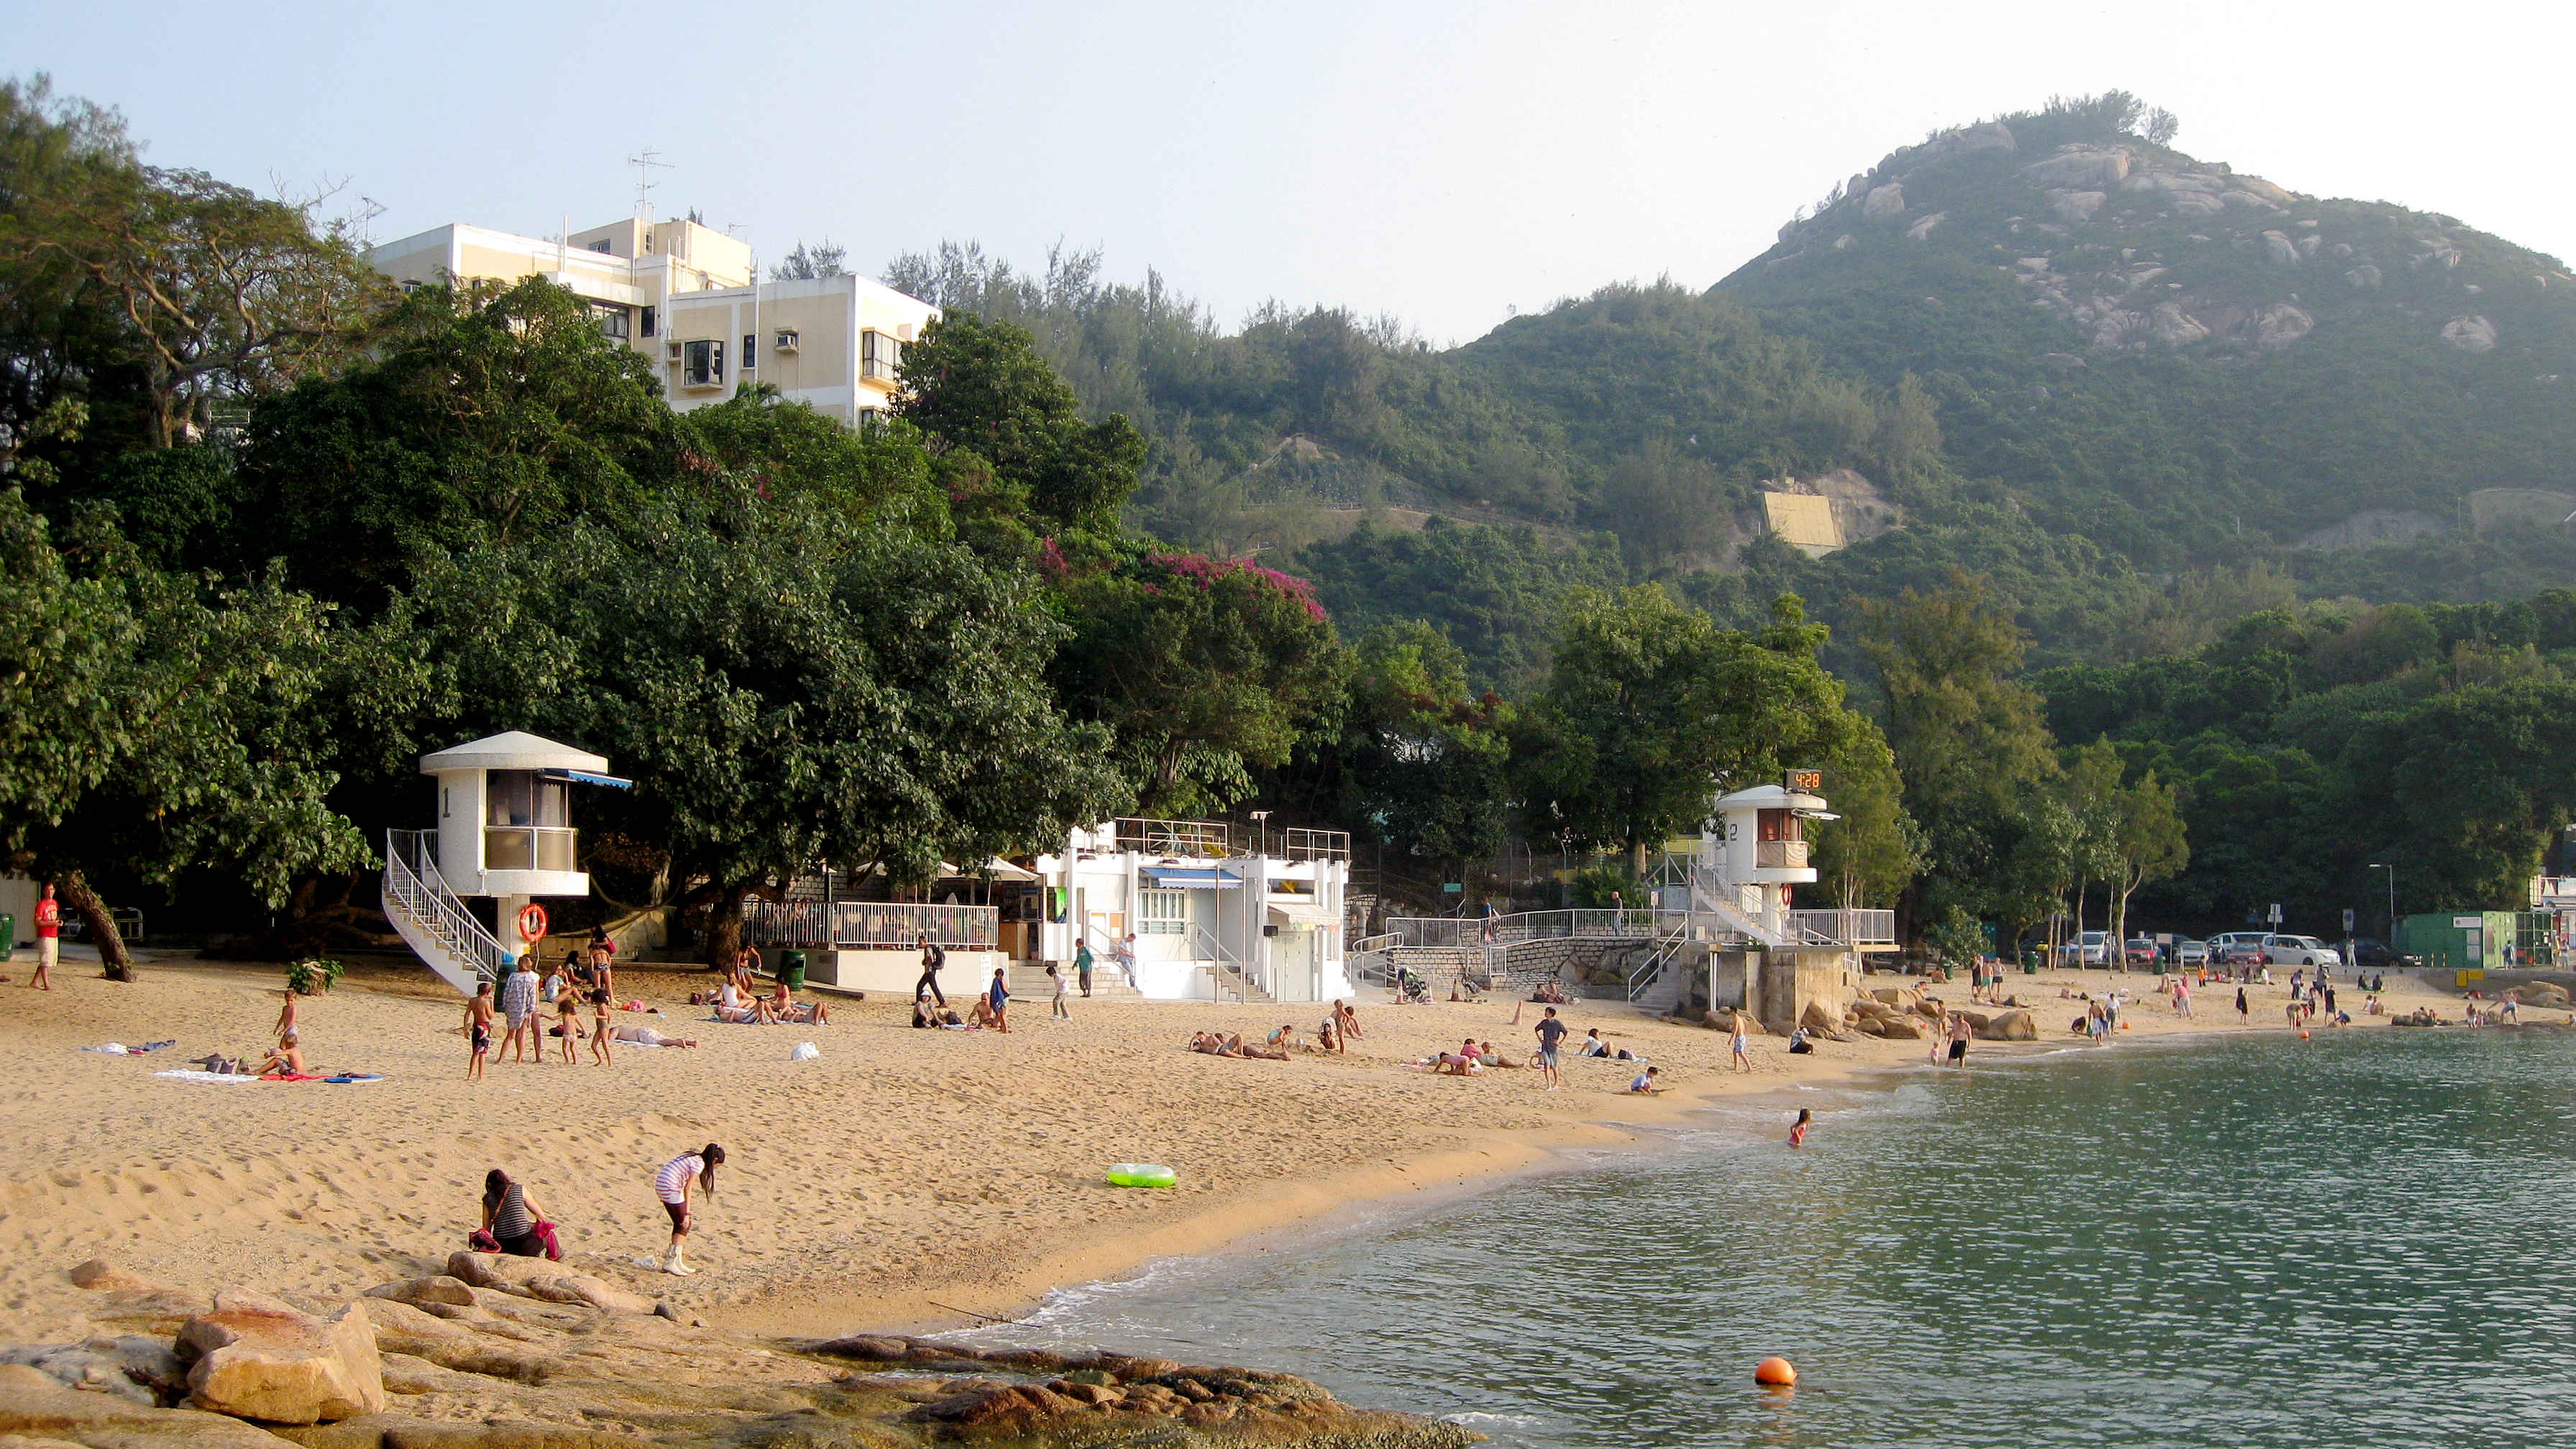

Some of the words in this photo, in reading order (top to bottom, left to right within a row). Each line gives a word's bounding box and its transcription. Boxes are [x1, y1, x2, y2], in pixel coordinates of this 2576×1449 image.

[1795, 773, 1820, 788] 4:28
[442, 787, 451, 818] 1
[1730, 823, 1738, 841] 2
